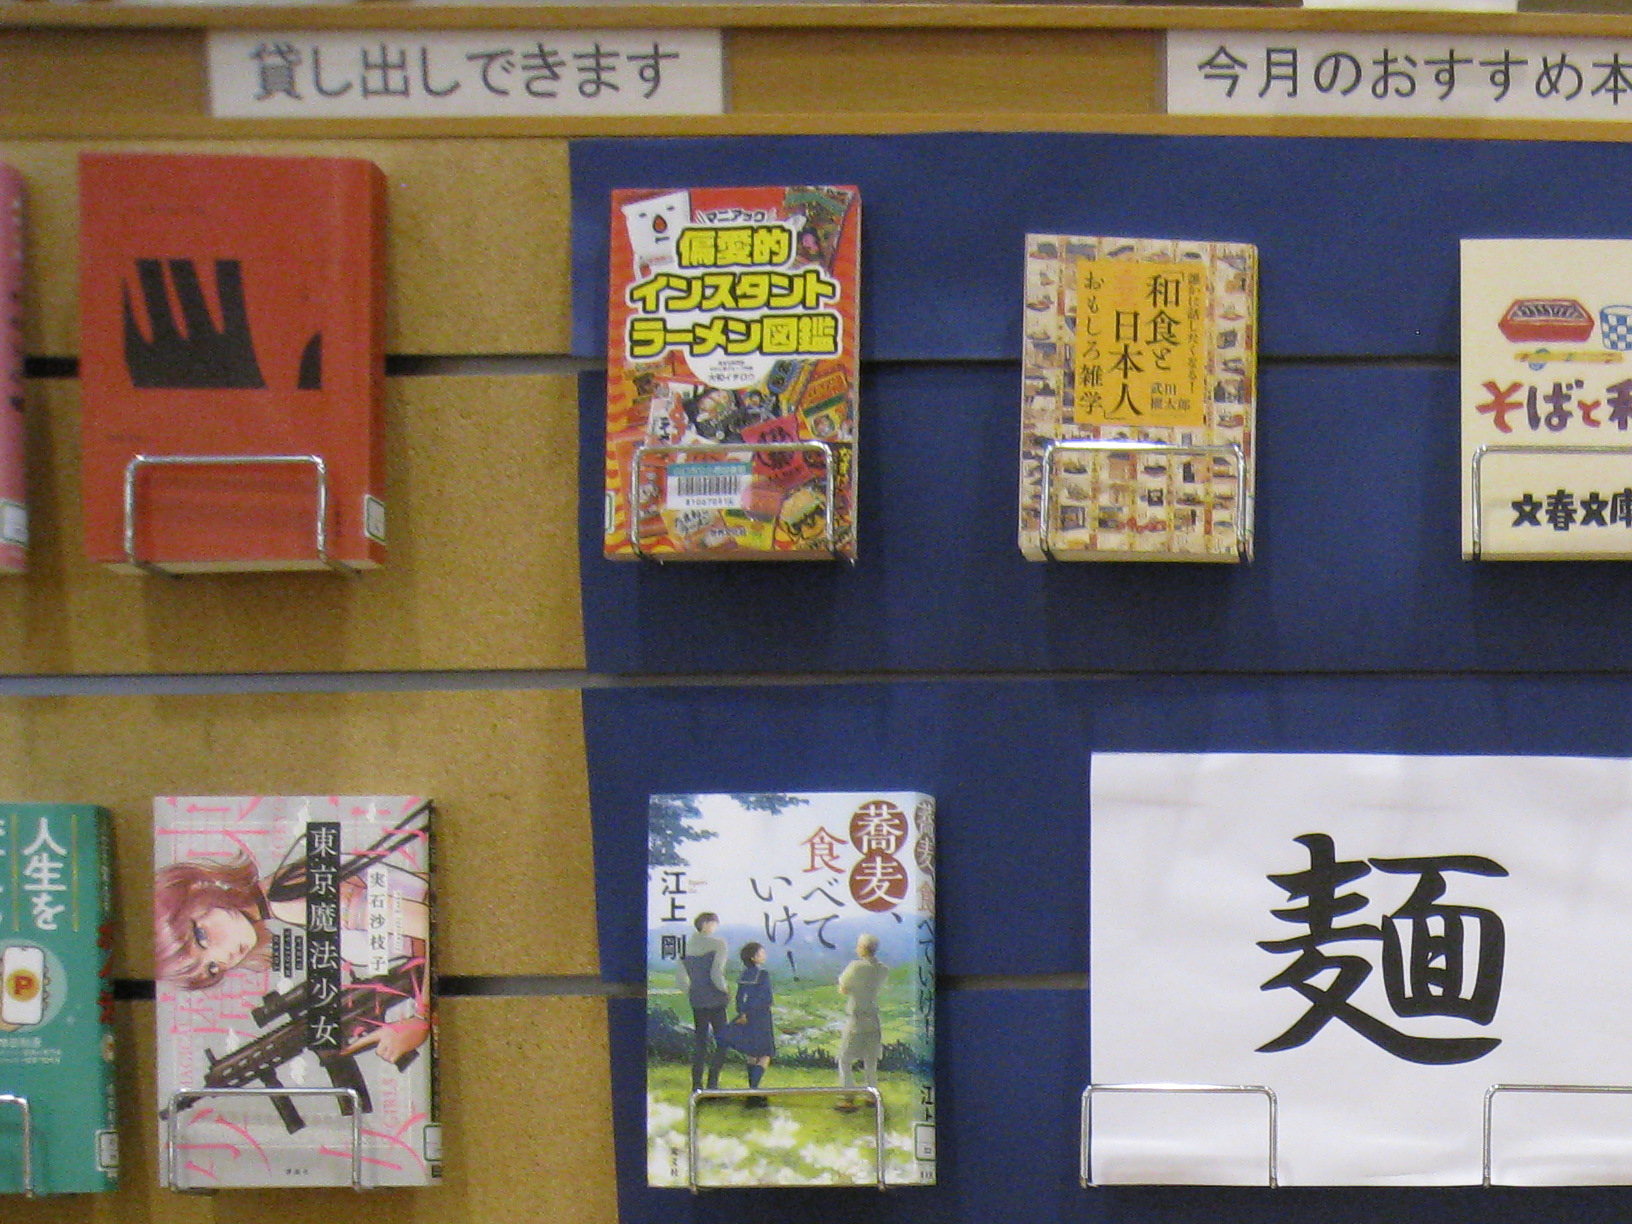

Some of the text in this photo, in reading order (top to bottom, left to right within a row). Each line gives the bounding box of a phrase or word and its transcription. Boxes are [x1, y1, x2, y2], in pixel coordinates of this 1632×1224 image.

[252, 42, 680, 101] 貸し出しできます
[676, 226, 790, 267] 偏愛的
[706, 210, 765, 223] マニアック
[630, 271, 835, 313] インスタント
[630, 314, 838, 357] ラーメン図鑑
[1079, 272, 1105, 415] おもしろ雑学
[24, 817, 67, 930] 人生を
[660, 871, 687, 961] 江上 剛
[801, 826, 849, 950] 食べて
[309, 827, 339, 1047] 東京魔法少女
[1254, 832, 1510, 1066] 麺
